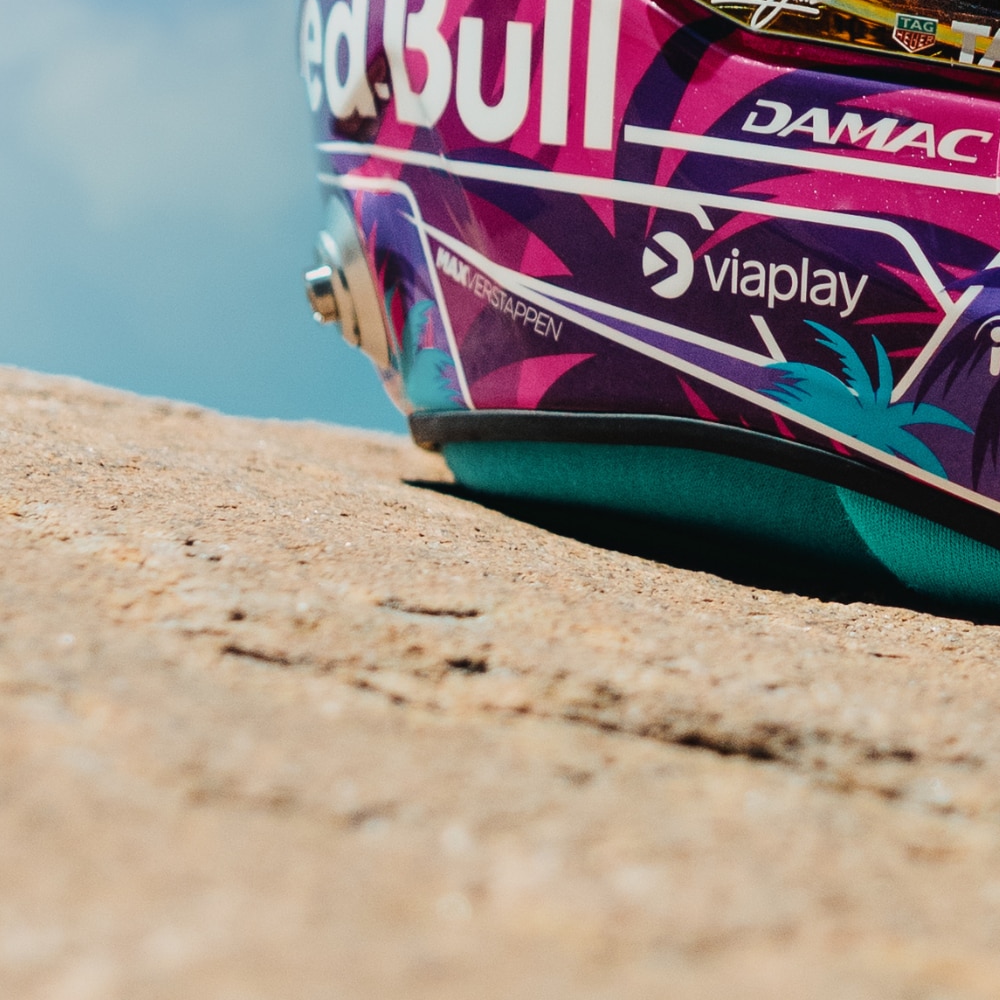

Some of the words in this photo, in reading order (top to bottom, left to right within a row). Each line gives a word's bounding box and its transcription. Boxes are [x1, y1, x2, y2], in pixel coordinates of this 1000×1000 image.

[895, 30, 935, 50] HEUER
[901, 17, 935, 33] TAG
[742, 99, 993, 164] DAMAC
[703, 248, 869, 318] viaplay
